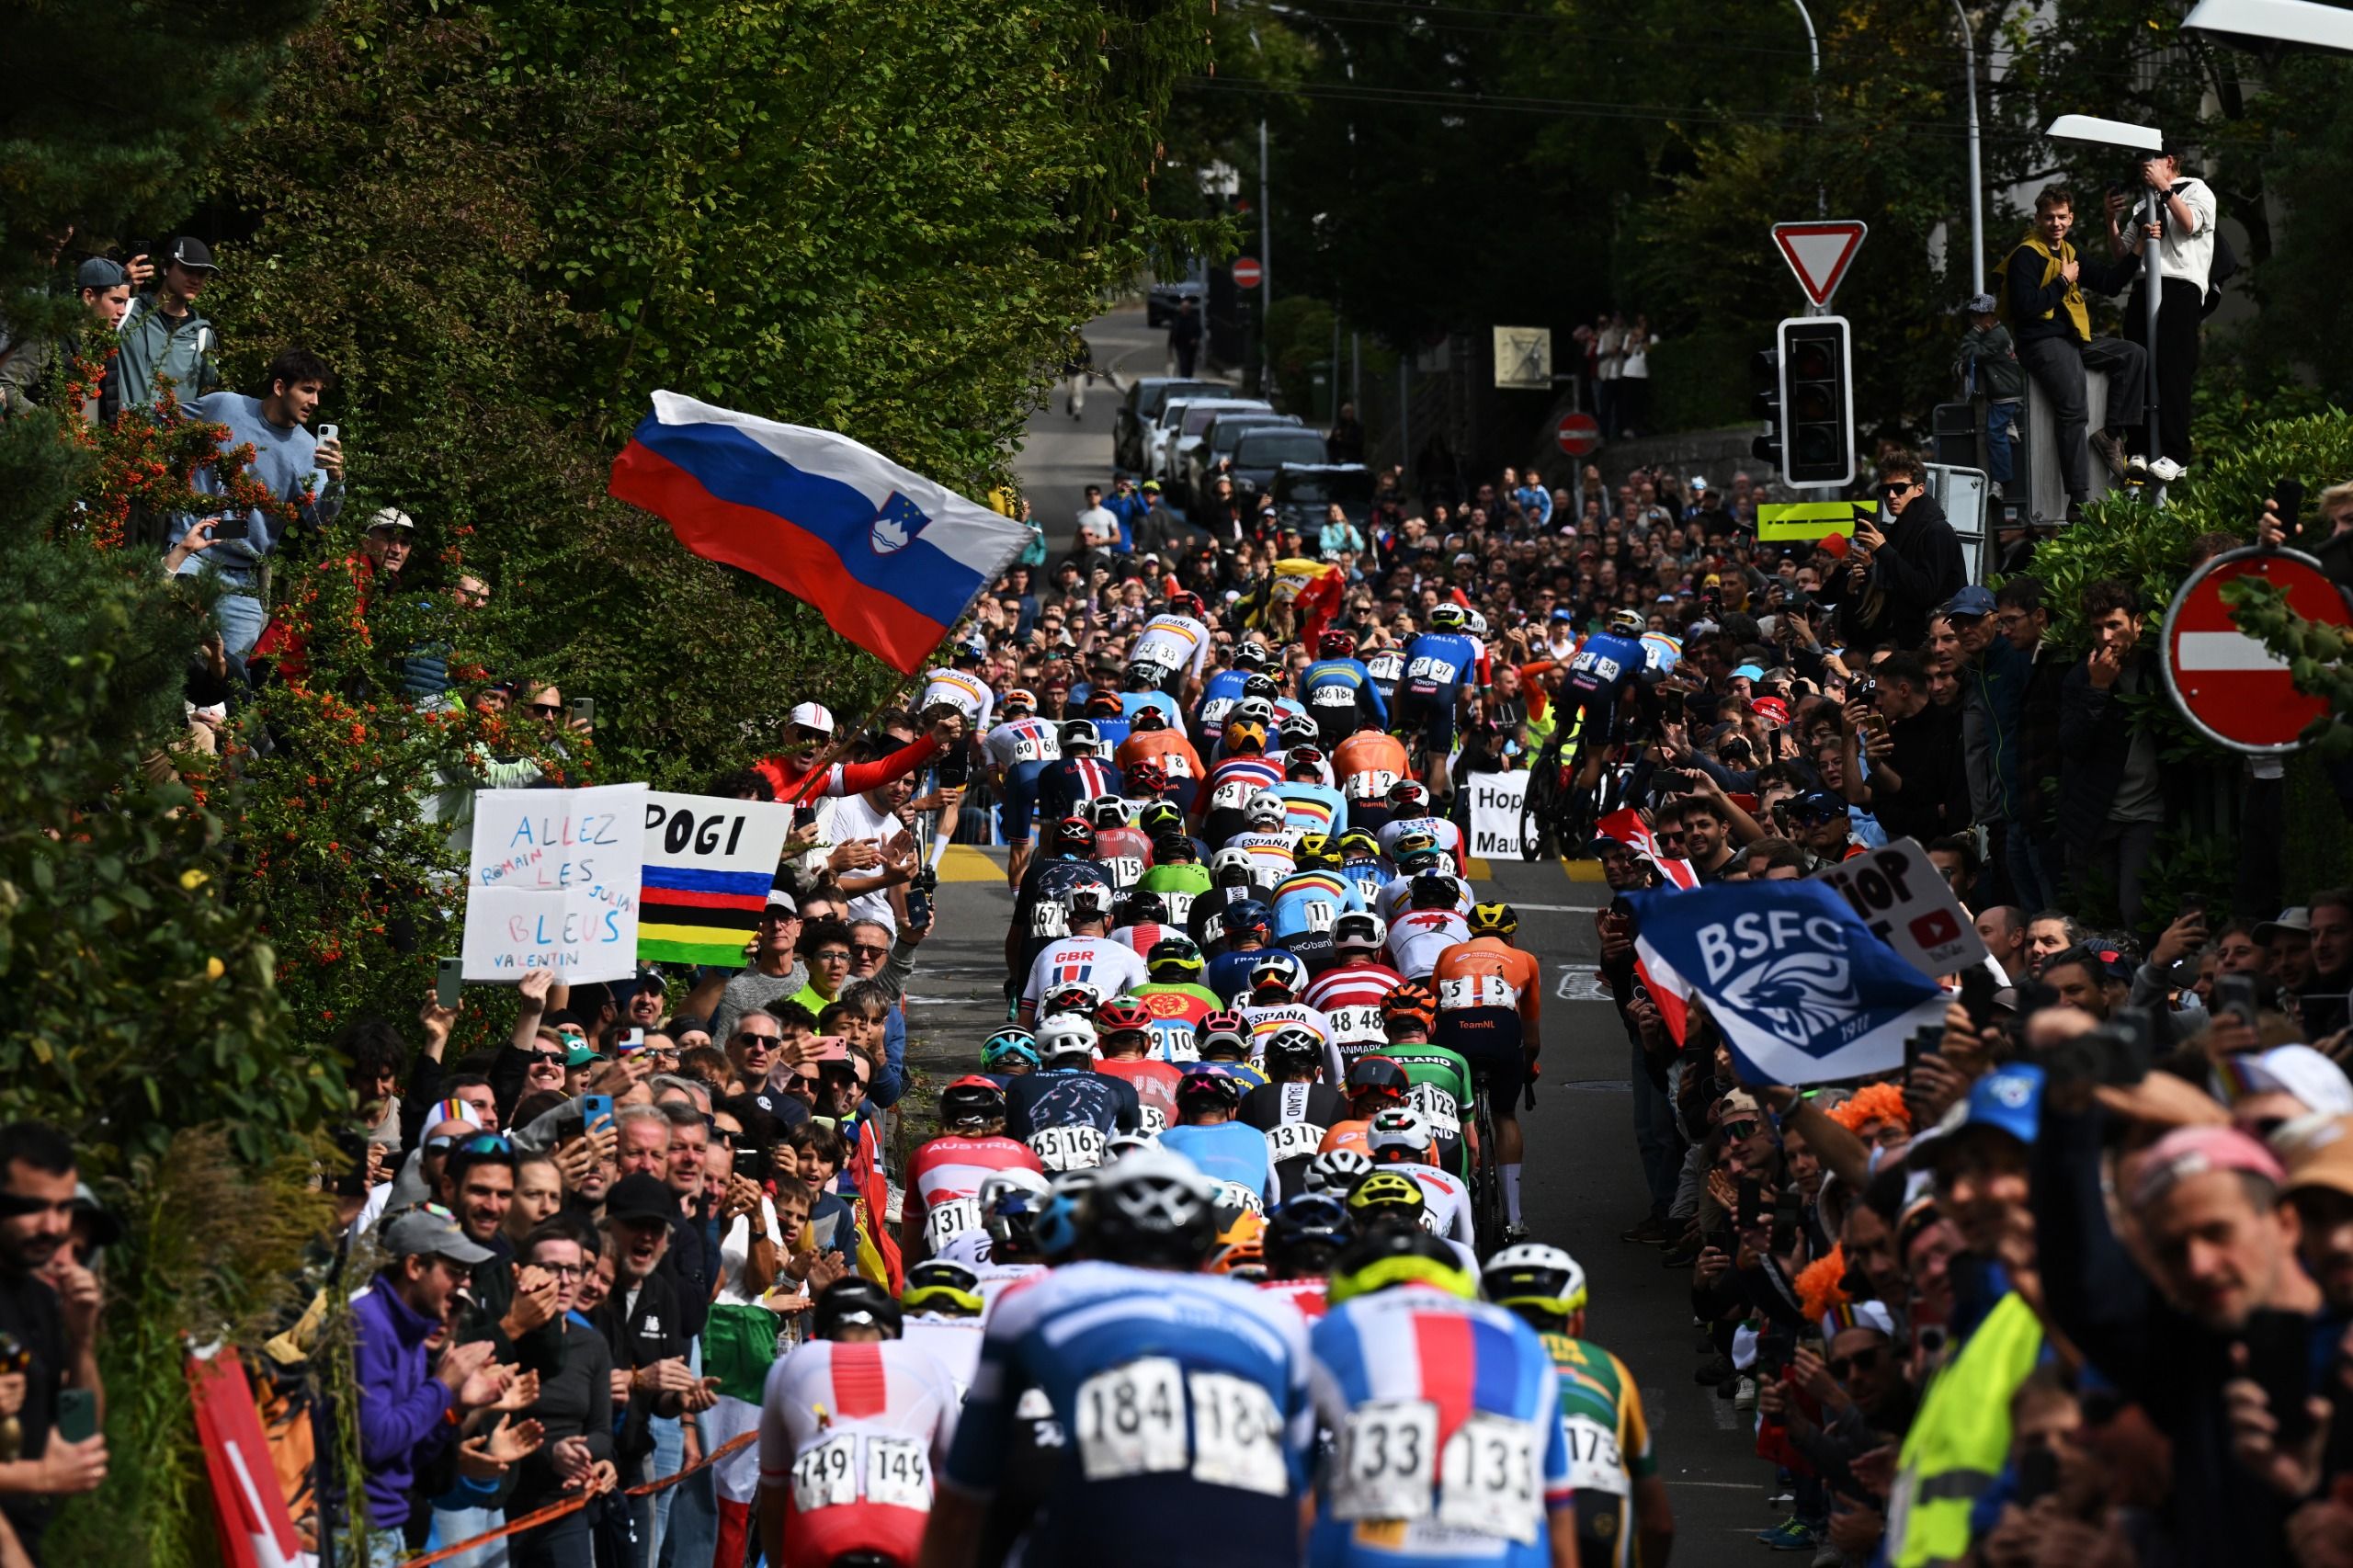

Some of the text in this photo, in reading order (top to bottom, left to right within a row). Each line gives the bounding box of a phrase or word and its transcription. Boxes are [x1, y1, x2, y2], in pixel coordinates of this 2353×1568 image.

[1162, 647, 1176, 661] 33
[1371, 660, 1385, 670] 89
[1413, 659, 1427, 670] 37
[1436, 664, 1449, 676] 37
[1602, 662, 1617, 675] 38
[1222, 676, 1246, 685] ITAL
[1415, 678, 1438, 687] TOYOTA
[1205, 702, 1220, 714] 39
[1017, 742, 1031, 755] 60
[1176, 756, 1184, 768] 8
[1382, 773, 1391, 787] 2
[1217, 784, 1233, 799] 95
[1479, 788, 1522, 813] Hop
[510, 812, 618, 848] ALLEZ
[645, 803, 746, 856] POGI
[1242, 837, 1290, 849] ESPAÑA
[1477, 832, 1539, 853] Mauo
[538, 858, 593, 886] LES
[588, 885, 638, 915] JULIAN
[1312, 903, 1329, 921] 11
[509, 910, 620, 946] BLEUS
[1697, 910, 1848, 985] BSFC
[494, 950, 579, 970] VALENTIN
[1055, 950, 1095, 963] GBR
[1234, 956, 1263, 965] FRAN
[1450, 981, 1461, 998] 5
[1495, 979, 1505, 995] 5
[1332, 1011, 1352, 1033] 48
[1359, 1010, 1383, 1030] 48
[1459, 1020, 1495, 1029] TeamNL
[1338, 1044, 1381, 1054] ANMARK
[1394, 1057, 1451, 1067] ELAND
[1429, 1089, 1456, 1119] 123
[926, 1141, 1022, 1154] AUSTRIA
[1067, 1131, 1101, 1154] 165
[931, 1207, 964, 1235] 131
[1091, 1380, 1173, 1444] 184
[1565, 1426, 1620, 1470] 173
[801, 1449, 847, 1487] 149
[879, 1449, 925, 1486] 149
